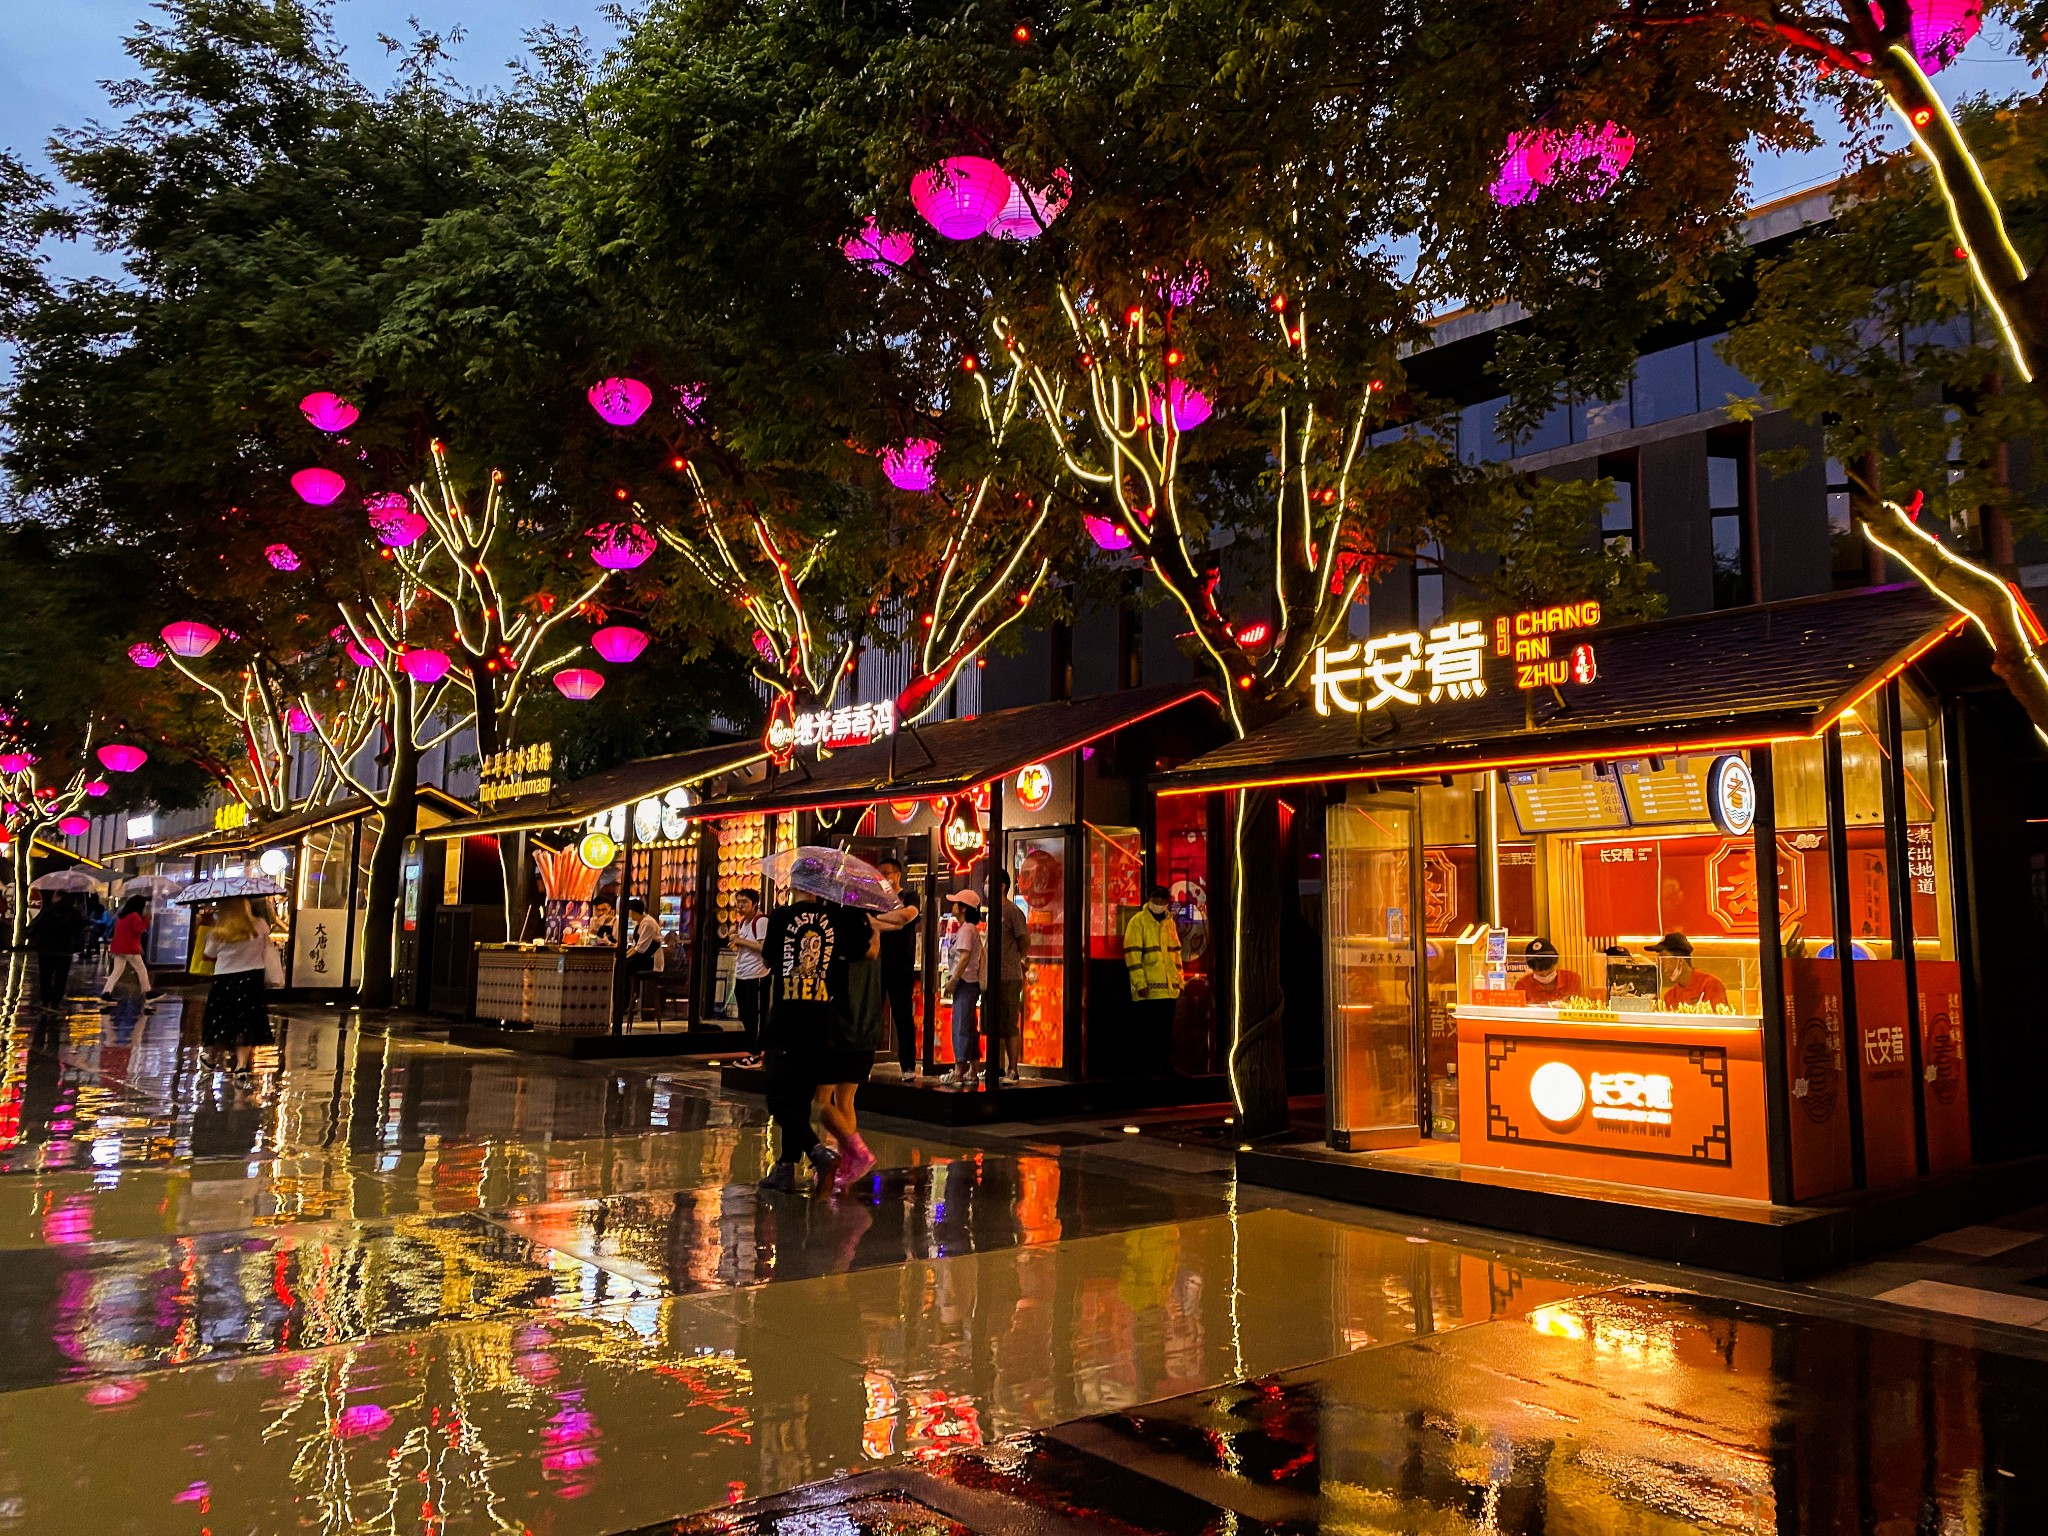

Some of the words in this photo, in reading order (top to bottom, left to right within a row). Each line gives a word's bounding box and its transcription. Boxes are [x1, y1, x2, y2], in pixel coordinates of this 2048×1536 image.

[1515, 602, 1600, 636] CHANG
[1310, 621, 1488, 716] 长安煮
[1515, 637, 1549, 662] AN
[1518, 661, 1568, 688] ZHU
[794, 699, 894, 746] 继光香香鸡
[1600, 848, 1634, 862] 长安煮
[1915, 827, 1936, 895] 煮出地道
[309, 922, 328, 974] 大唐制造
[782, 936, 796, 977] HAPPY
[782, 977, 830, 1001] HEA
[1864, 1026, 1905, 1065] 长安煮
